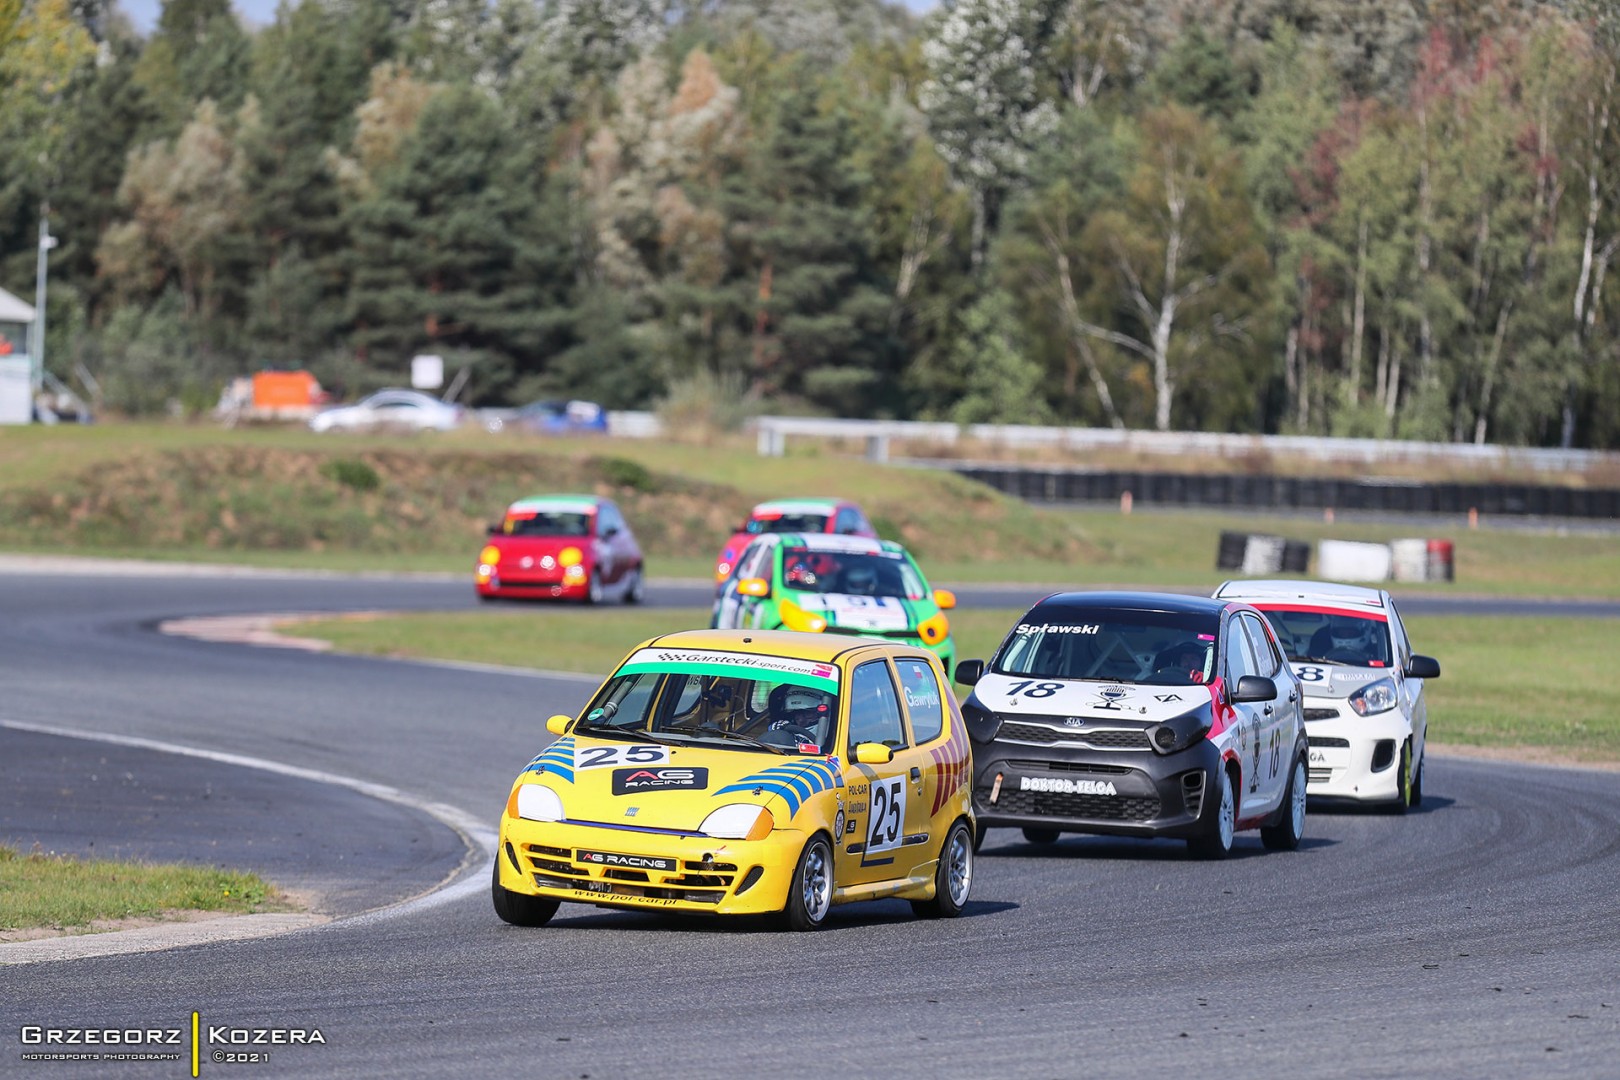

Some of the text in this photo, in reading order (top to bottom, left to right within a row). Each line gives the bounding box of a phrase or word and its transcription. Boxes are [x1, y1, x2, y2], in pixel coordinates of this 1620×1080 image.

[1015, 623, 1099, 635] Spławski
[686, 653, 812, 675] Garstecki-sport.com
[1006, 680, 1065, 698] 18
[1064, 717, 1084, 727] KIA
[579, 745, 664, 768] 25
[1268, 727, 1281, 780] 18
[625, 769, 695, 782] AG
[625, 779, 695, 788] RACING
[848, 784, 868, 796] POL-CAR
[870, 782, 901, 847] 25
[583, 853, 667, 868] AG RACING
[574, 889, 678, 906] www.pol-car.pl
